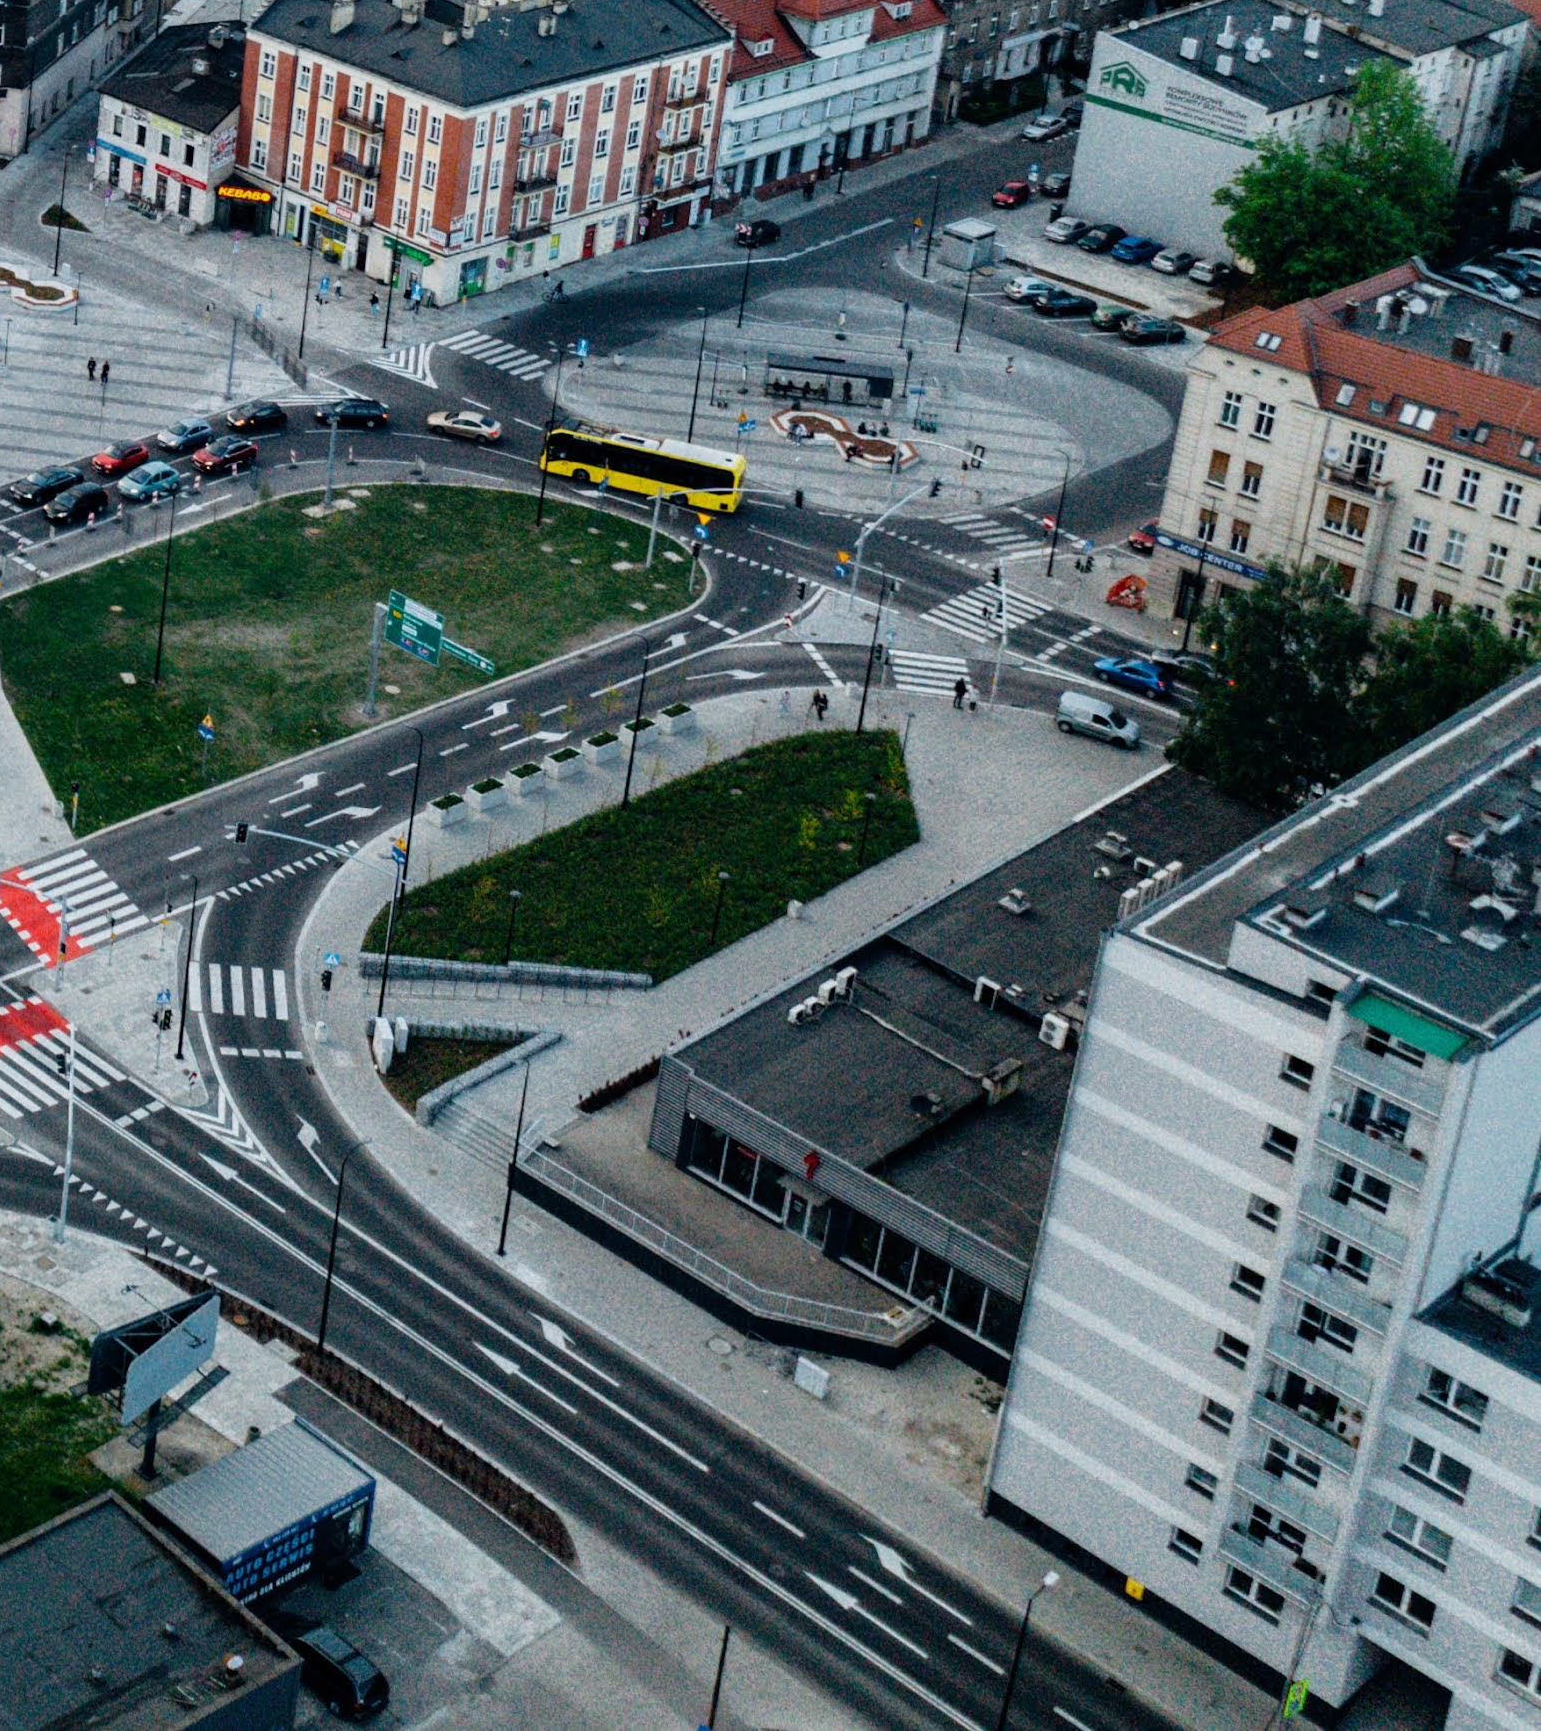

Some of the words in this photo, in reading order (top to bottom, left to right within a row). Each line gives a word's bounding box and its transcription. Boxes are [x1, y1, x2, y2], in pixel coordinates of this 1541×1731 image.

[1176, 543, 1199, 557] JOB
[226, 1556, 263, 1584] AUTO
[266, 1528, 315, 1563] CZĘŚCI
[262, 1543, 314, 1579] SERWIS
[259, 1582, 274, 1596] DLA
[275, 1560, 312, 1587] KLIENTÓW
